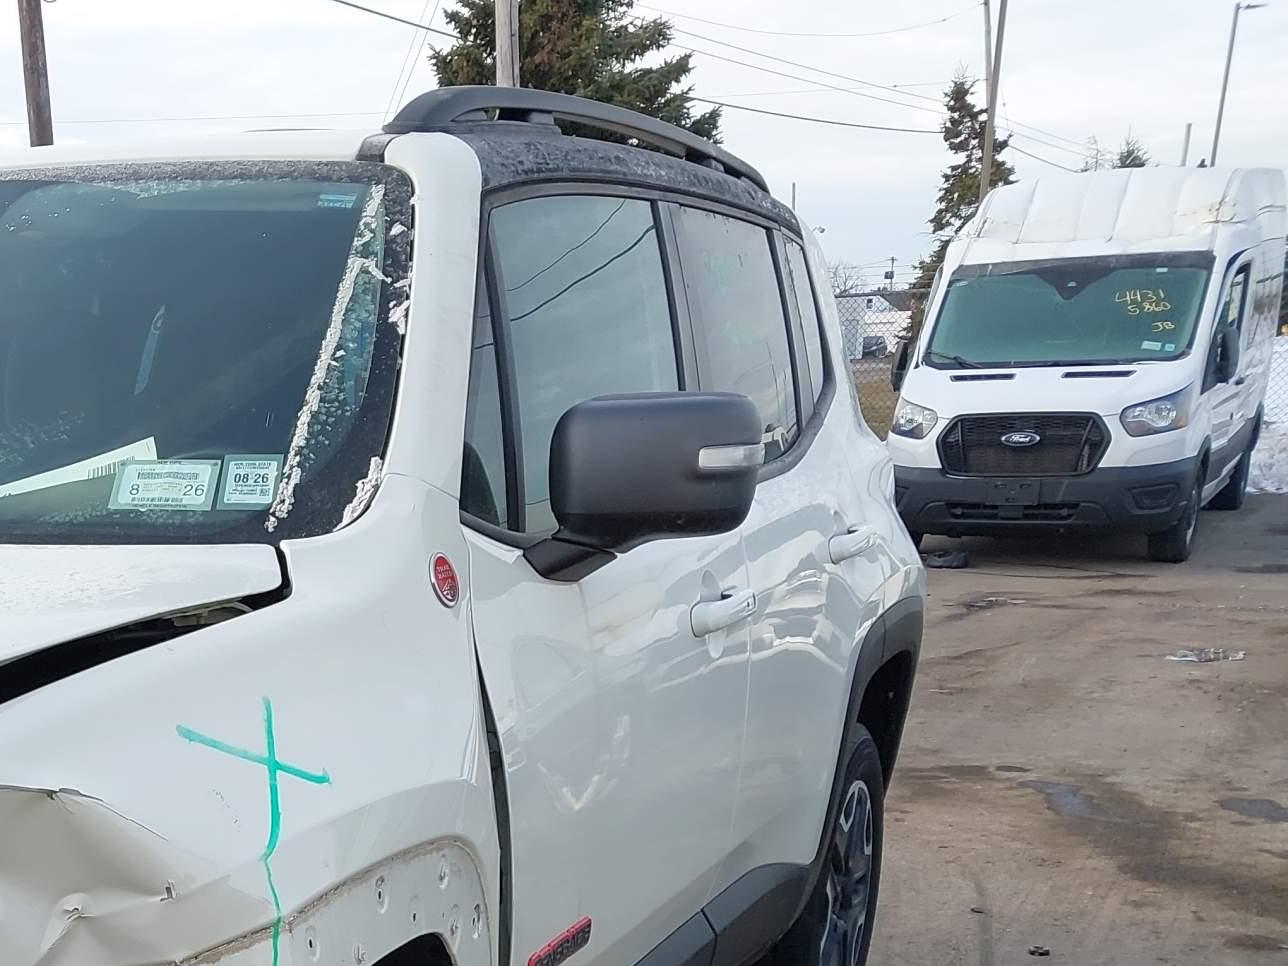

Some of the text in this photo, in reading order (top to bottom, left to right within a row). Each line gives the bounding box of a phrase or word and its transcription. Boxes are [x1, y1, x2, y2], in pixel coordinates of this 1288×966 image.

[1115, 289, 1165, 305] 4431
[128, 483, 141, 496] 8
[183, 483, 206, 497] 26
